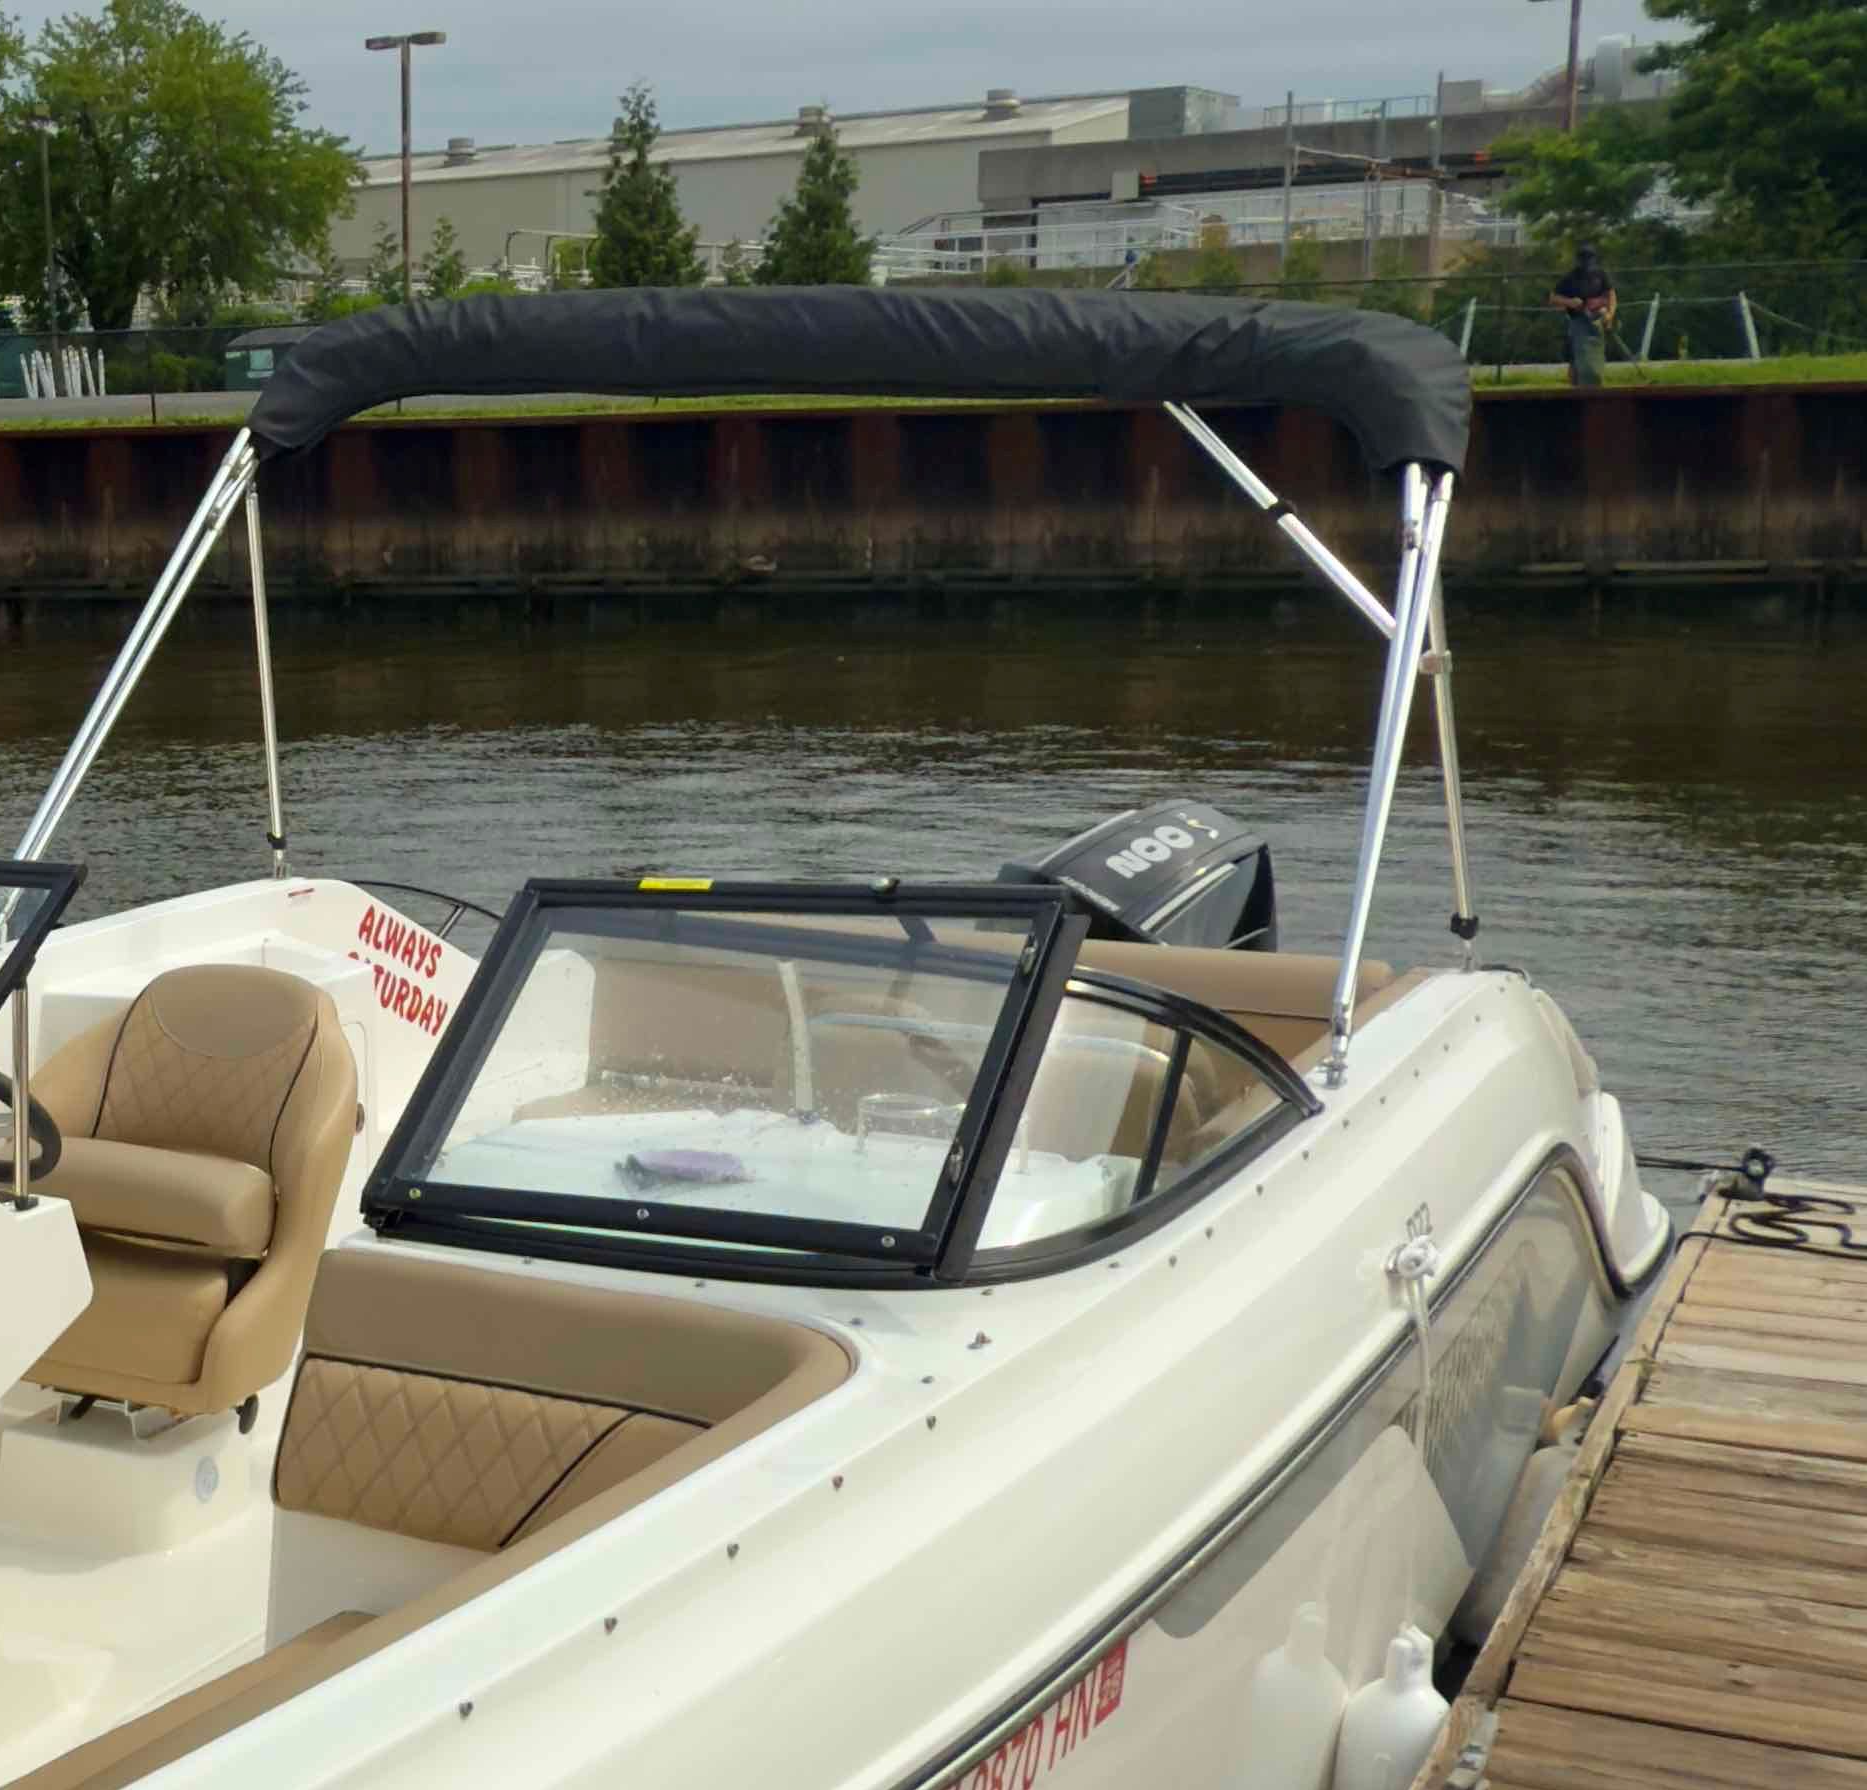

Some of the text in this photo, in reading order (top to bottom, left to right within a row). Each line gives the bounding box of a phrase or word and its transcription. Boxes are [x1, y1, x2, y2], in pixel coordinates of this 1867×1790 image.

[358, 904, 442, 978] ALWAYS
[348, 952, 448, 1036] TURDAY
[1048, 1668, 1098, 1771] HN
